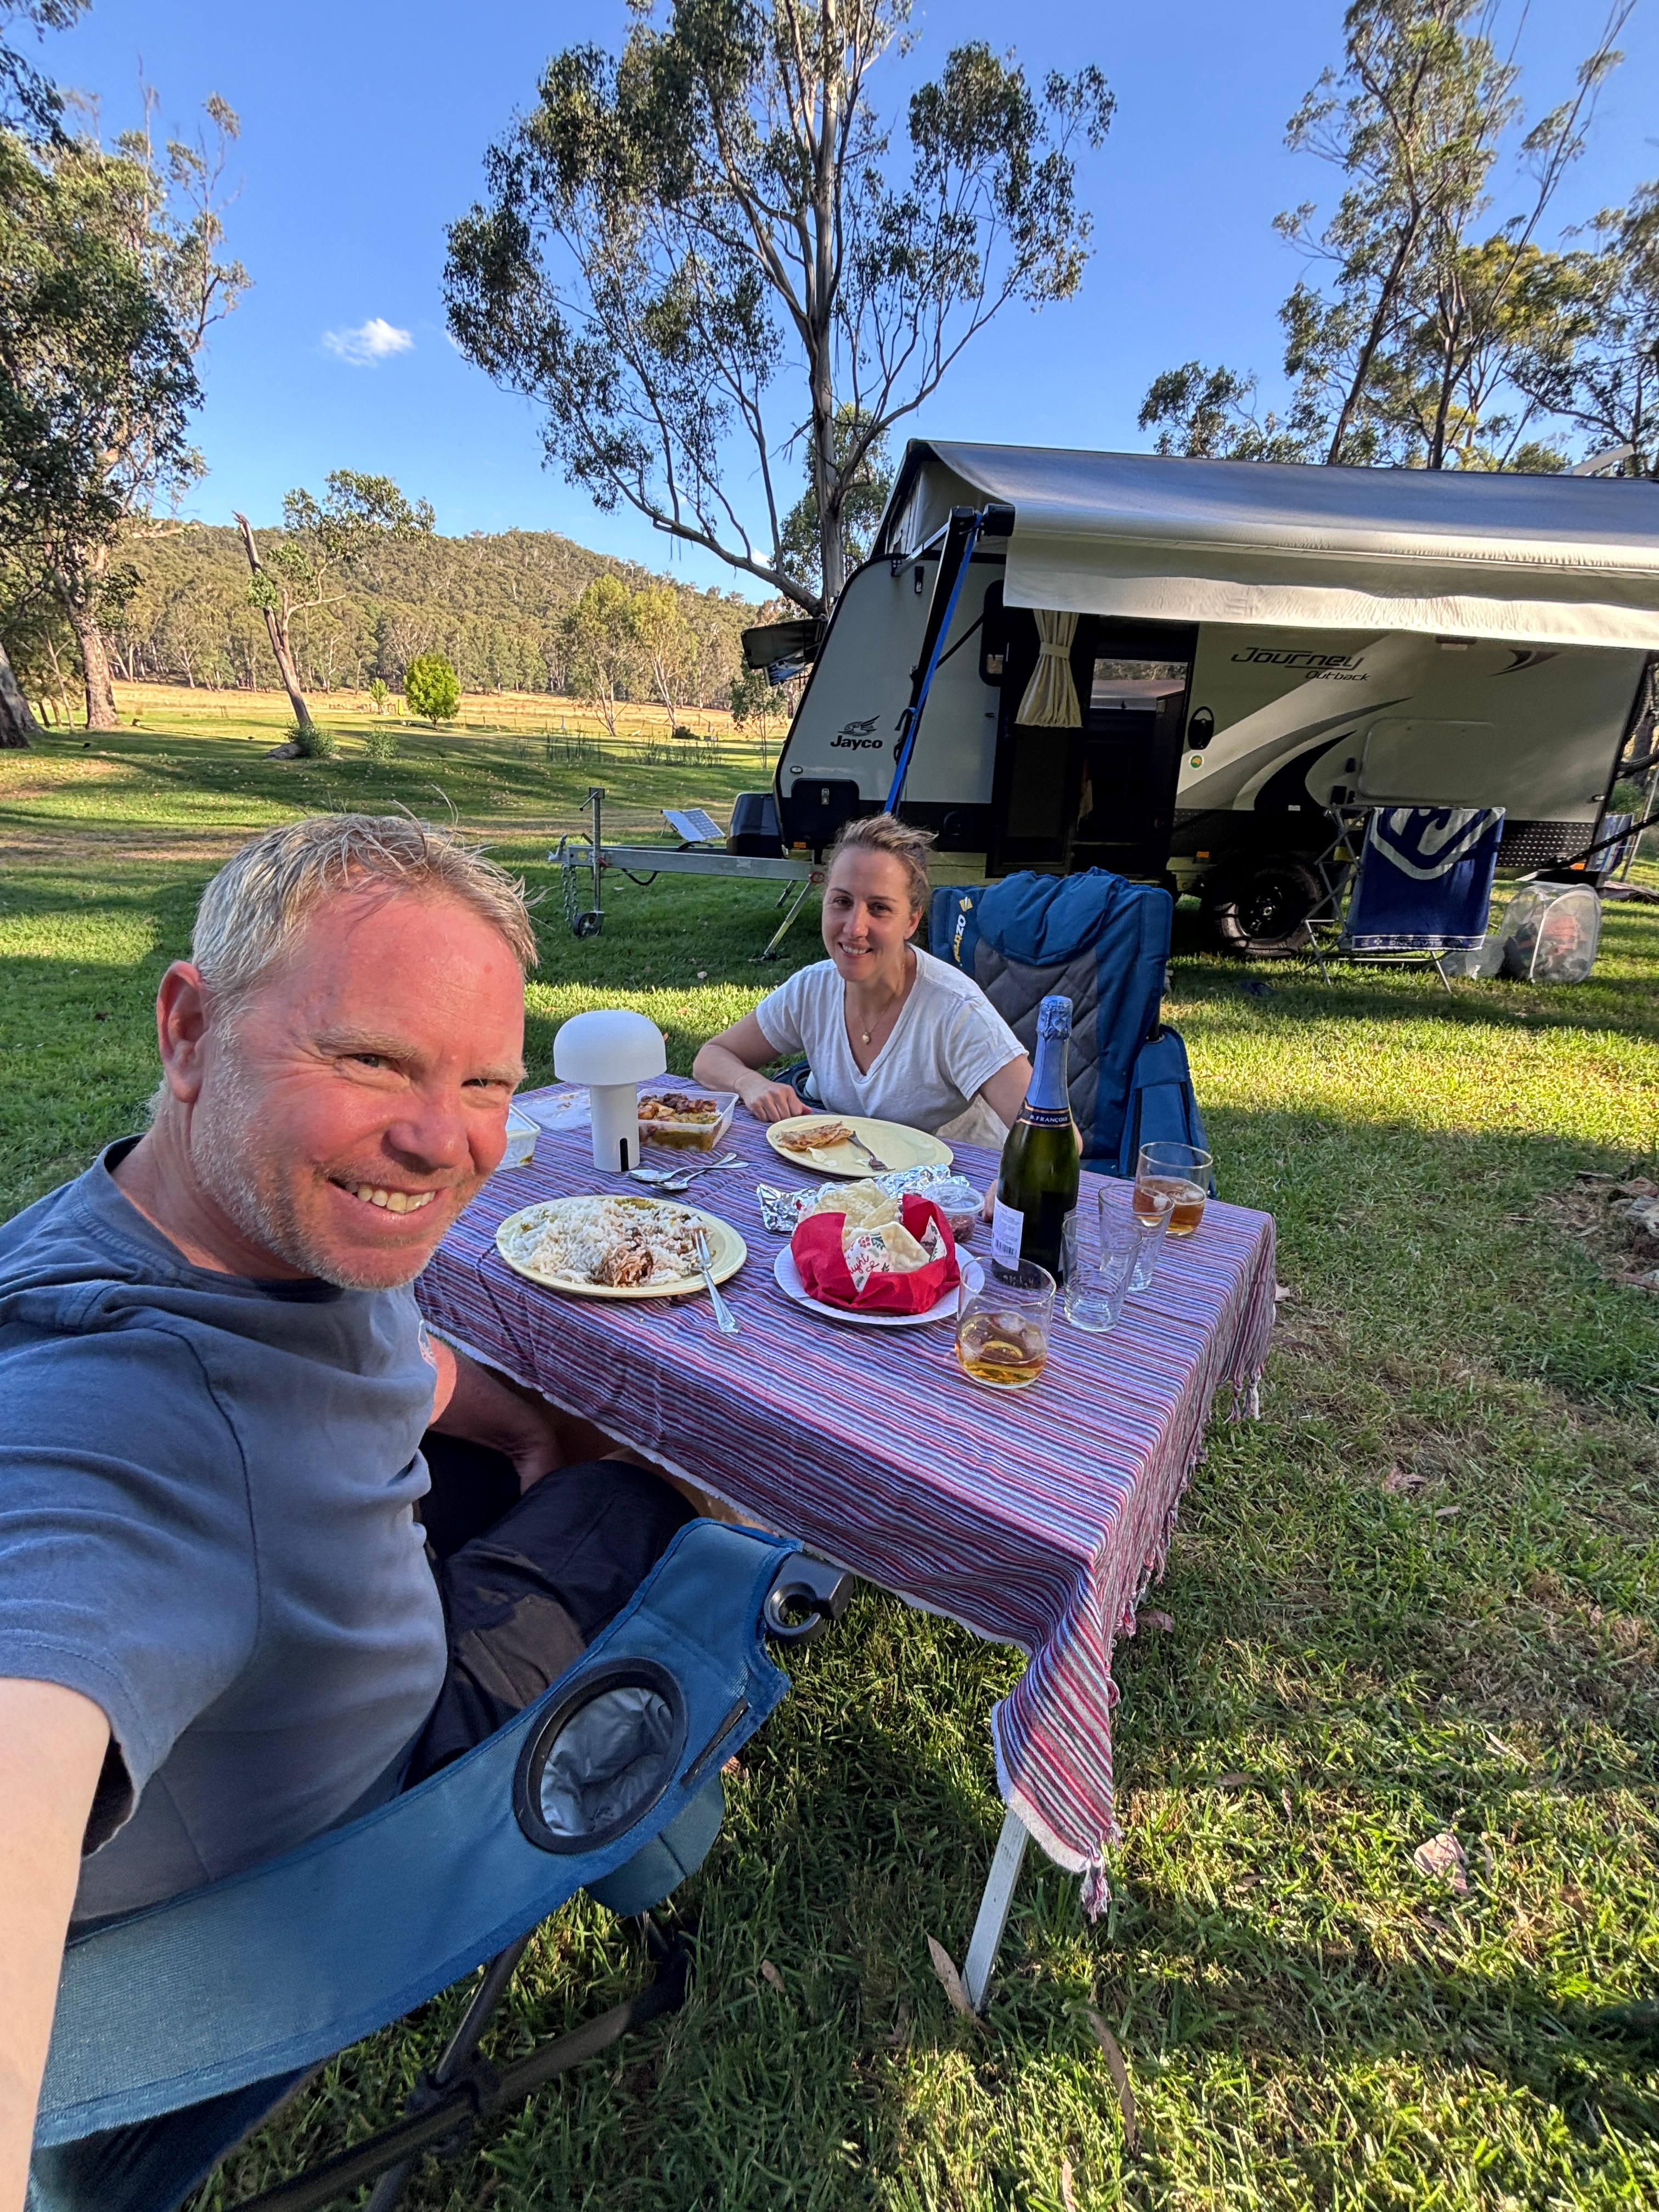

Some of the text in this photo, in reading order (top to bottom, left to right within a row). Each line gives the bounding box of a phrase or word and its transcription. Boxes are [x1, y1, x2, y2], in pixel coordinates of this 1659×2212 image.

[1231, 647, 1364, 670] Journey
[1305, 670, 1371, 681] Outback
[830, 735, 883, 751] Jayco
